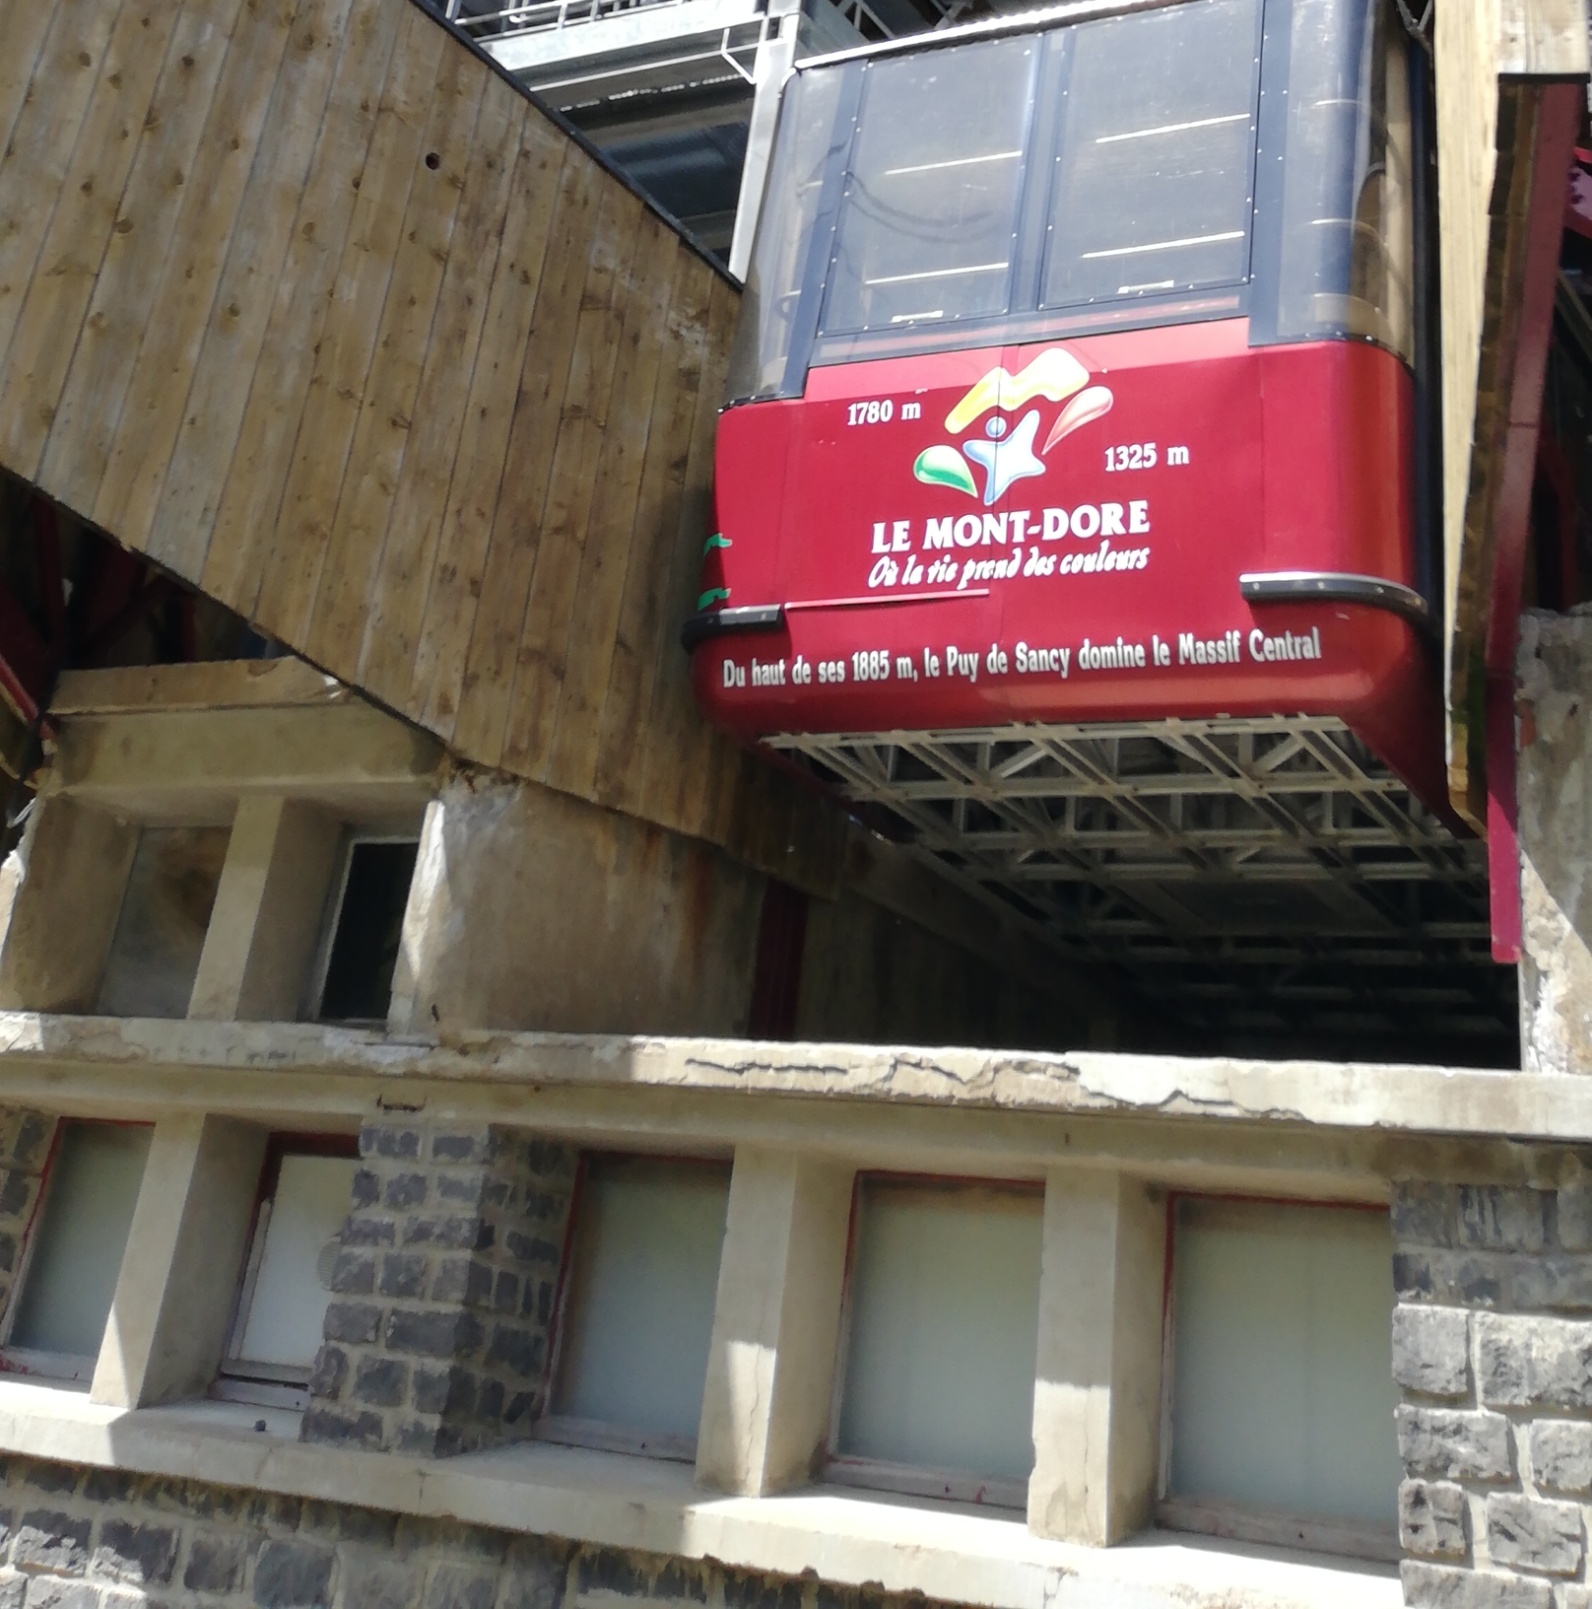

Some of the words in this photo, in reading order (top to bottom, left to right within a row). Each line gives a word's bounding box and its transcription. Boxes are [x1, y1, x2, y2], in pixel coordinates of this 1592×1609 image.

[847, 399, 893, 426] 1780
[901, 401, 921, 421] m
[1104, 442, 1157, 472] 1325
[1166, 445, 1190, 466] m
[871, 520, 912, 554] LE
[922, 499, 1151, 550] MONT-DORE
[868, 555, 898, 588] Où
[901, 554, 923, 585] la
[927, 555, 958, 583] vie
[956, 547, 1022, 590] prend
[1023, 546, 1055, 577] des
[1060, 539, 1151, 576] couleurs
[723, 659, 746, 688] Du
[751, 657, 786, 686] haut
[792, 655, 812, 684] de
[818, 660, 846, 683] ses
[852, 649, 890, 682] 1885
[896, 655, 918, 682] m,
[923, 646, 940, 677] le
[946, 645, 979, 683] Puy
[986, 642, 1008, 674] de
[1015, 641, 1070, 679] Sancy
[1078, 636, 1146, 670] domine
[1152, 634, 1171, 667] le
[1178, 629, 1241, 665] Massif
[1249, 625, 1322, 663] Central
